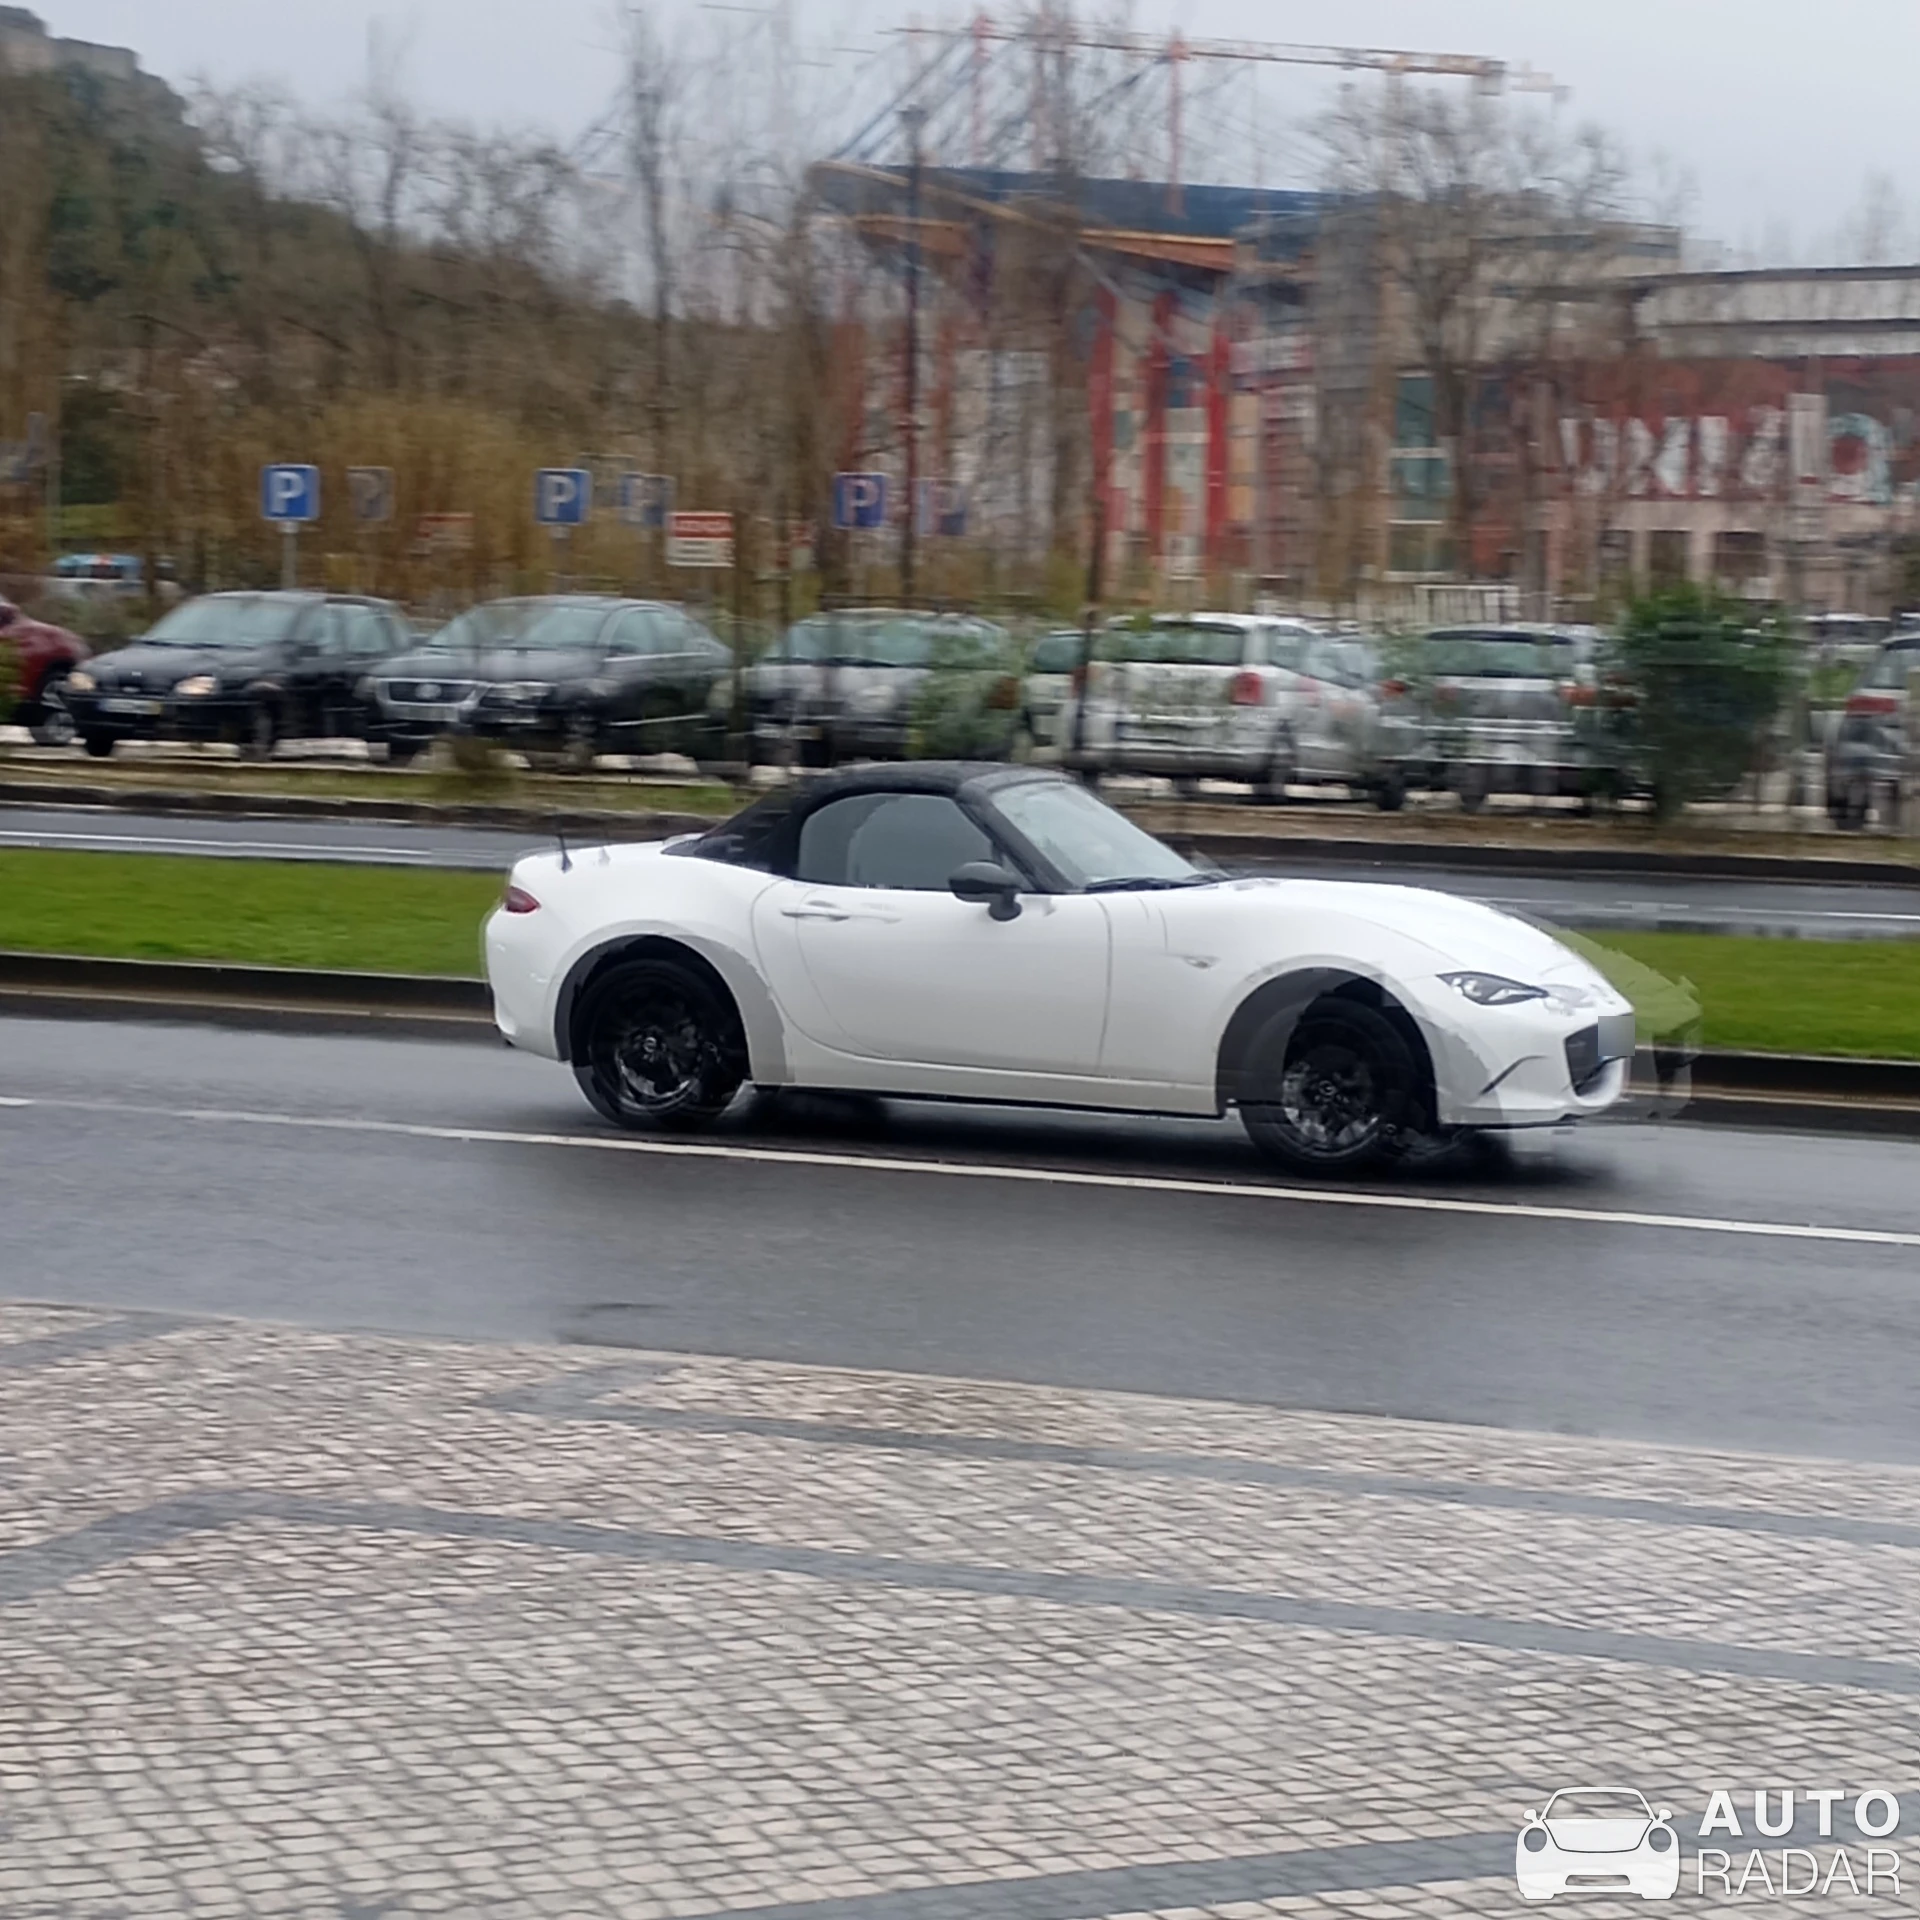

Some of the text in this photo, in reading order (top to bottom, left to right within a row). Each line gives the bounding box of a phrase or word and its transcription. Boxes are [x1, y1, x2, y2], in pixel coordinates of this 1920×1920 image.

[268, 471, 305, 514] P
[543, 474, 577, 518] P
[842, 477, 881, 524] P
